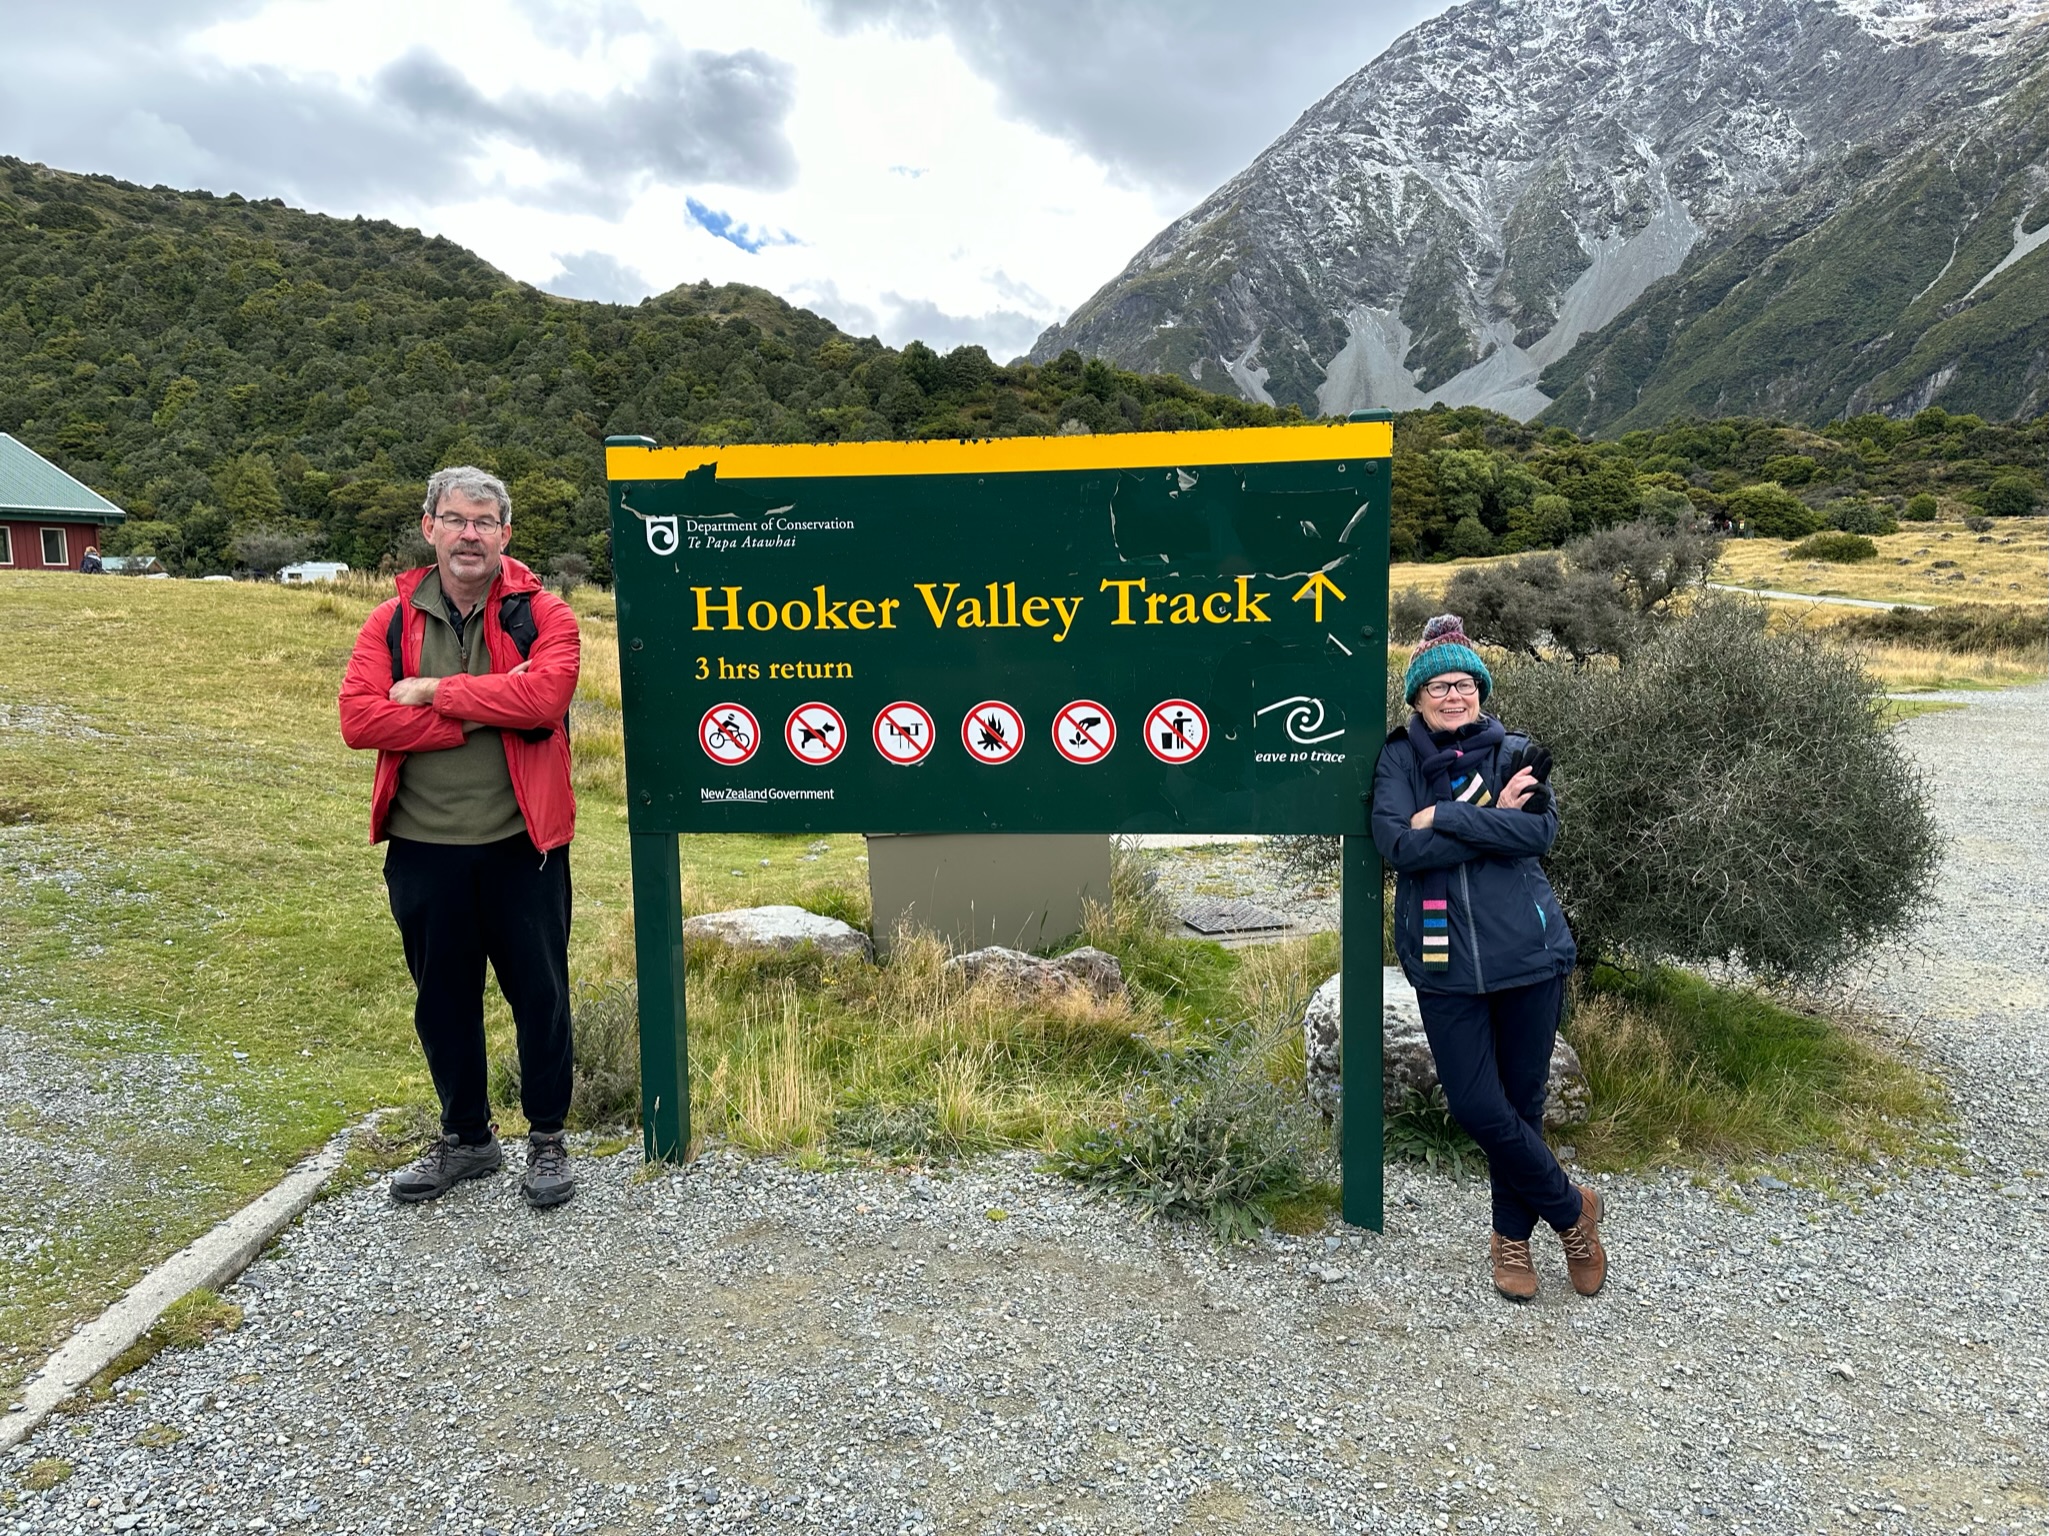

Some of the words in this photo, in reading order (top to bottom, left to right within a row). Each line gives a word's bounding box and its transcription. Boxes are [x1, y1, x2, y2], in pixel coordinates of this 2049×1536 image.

[686, 519, 758, 536] Department
[761, 517, 775, 531] of
[776, 517, 855, 531] Conservation
[688, 536, 702, 549] Te
[706, 536, 737, 552] Papa
[741, 534, 796, 548] Atawhai
[689, 585, 900, 631] Hooker
[913, 581, 1084, 643] Valley
[1100, 576, 1272, 625] Track
[695, 656, 710, 680] 3
[717, 656, 761, 680] hrs
[769, 660, 854, 679] return
[1254, 751, 1287, 763] eave
[1290, 751, 1308, 763] no
[1310, 750, 1346, 763] trace
[700, 788, 725, 800] New
[725, 788, 768, 800] Zealand
[768, 787, 835, 800] Government
